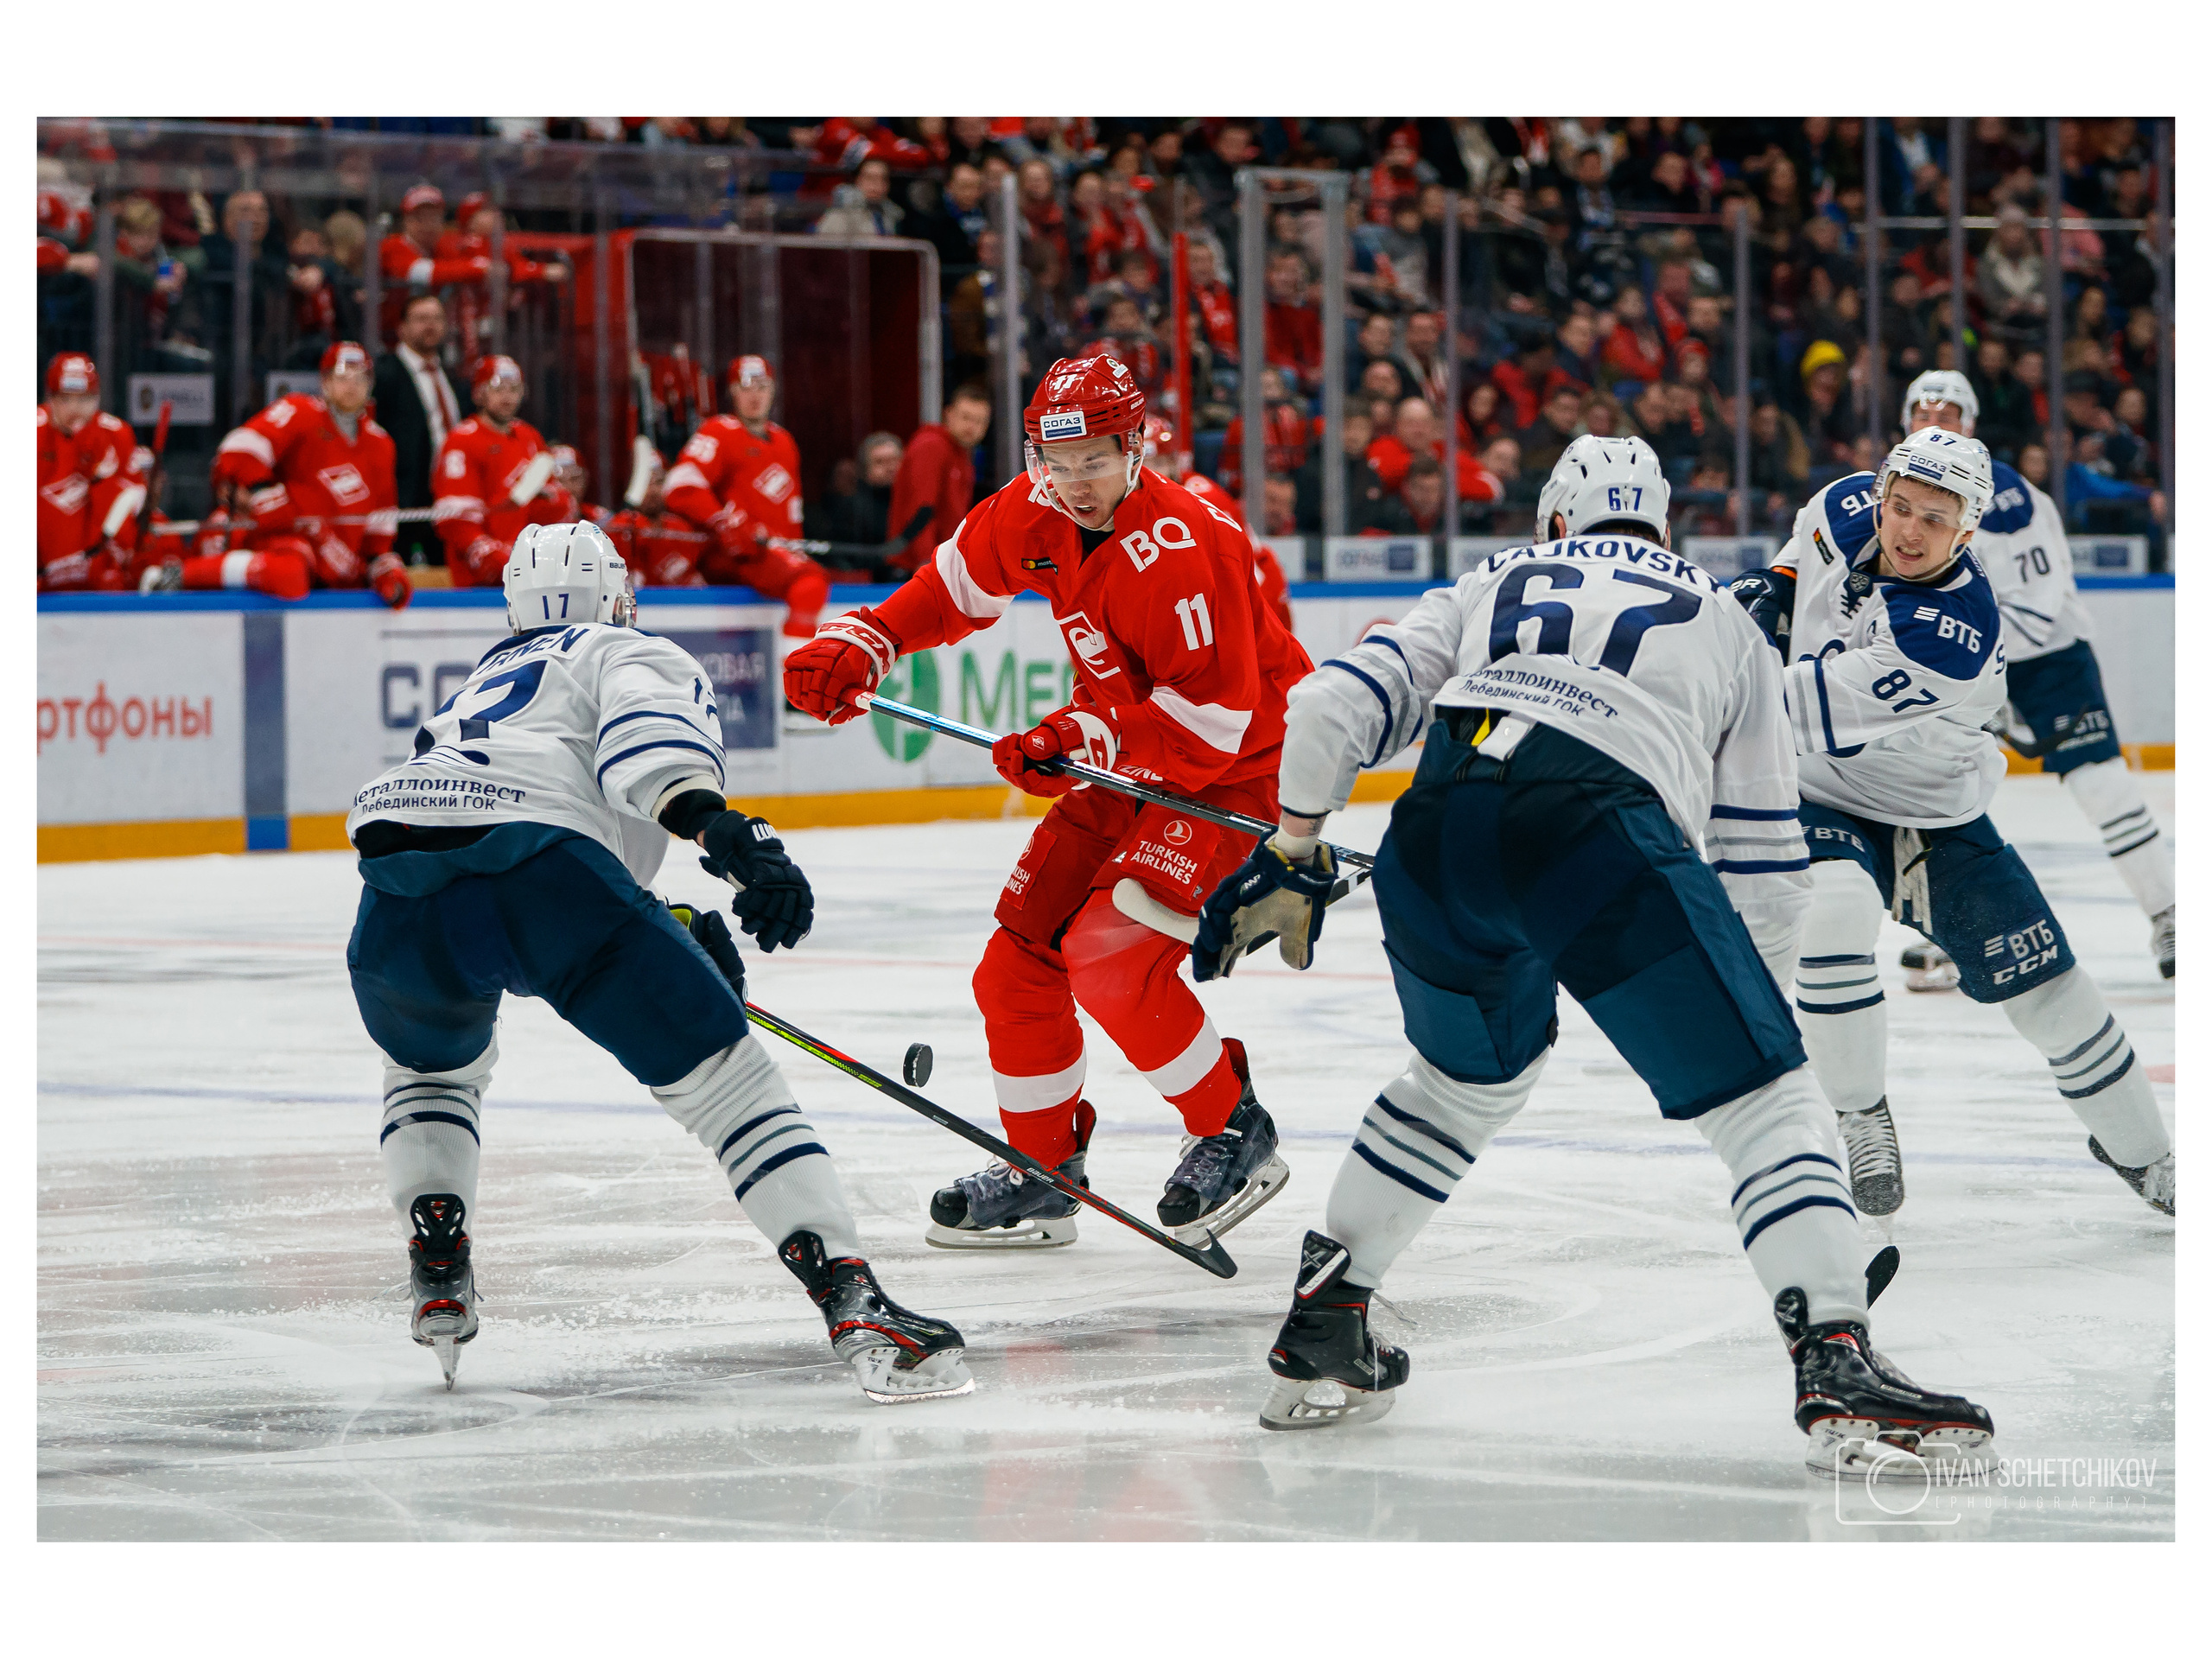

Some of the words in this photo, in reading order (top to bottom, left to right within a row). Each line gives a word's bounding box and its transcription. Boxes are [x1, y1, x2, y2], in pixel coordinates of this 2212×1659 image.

[1043, 416, 1082, 429] СОГАЗ
[1929, 434, 1957, 447] 87
[1910, 454, 1948, 473] СОГАЗ
[1608, 486, 1643, 512] 67
[1840, 489, 1880, 517] ТБ
[1120, 517, 1197, 573] BQ
[2014, 547, 2050, 583] 70
[542, 593, 569, 620] 17
[1488, 563, 1703, 677] 67
[1173, 593, 1213, 651] 11
[1937, 615, 1983, 654] ВТБ
[1872, 669, 1940, 714] 87
[1553, 698, 1585, 716] ГОК
[463, 796, 497, 810] ГОК
[1130, 851, 1192, 885] AIRLINES
[1139, 840, 1198, 874] TURKISH
[1006, 877, 1025, 895] INES
[1012, 866, 1031, 883] KISH
[2008, 919, 2055, 960] ВТБ
[1993, 944, 2059, 986] CCM
[1026, 1166, 1055, 1184] BAUER
